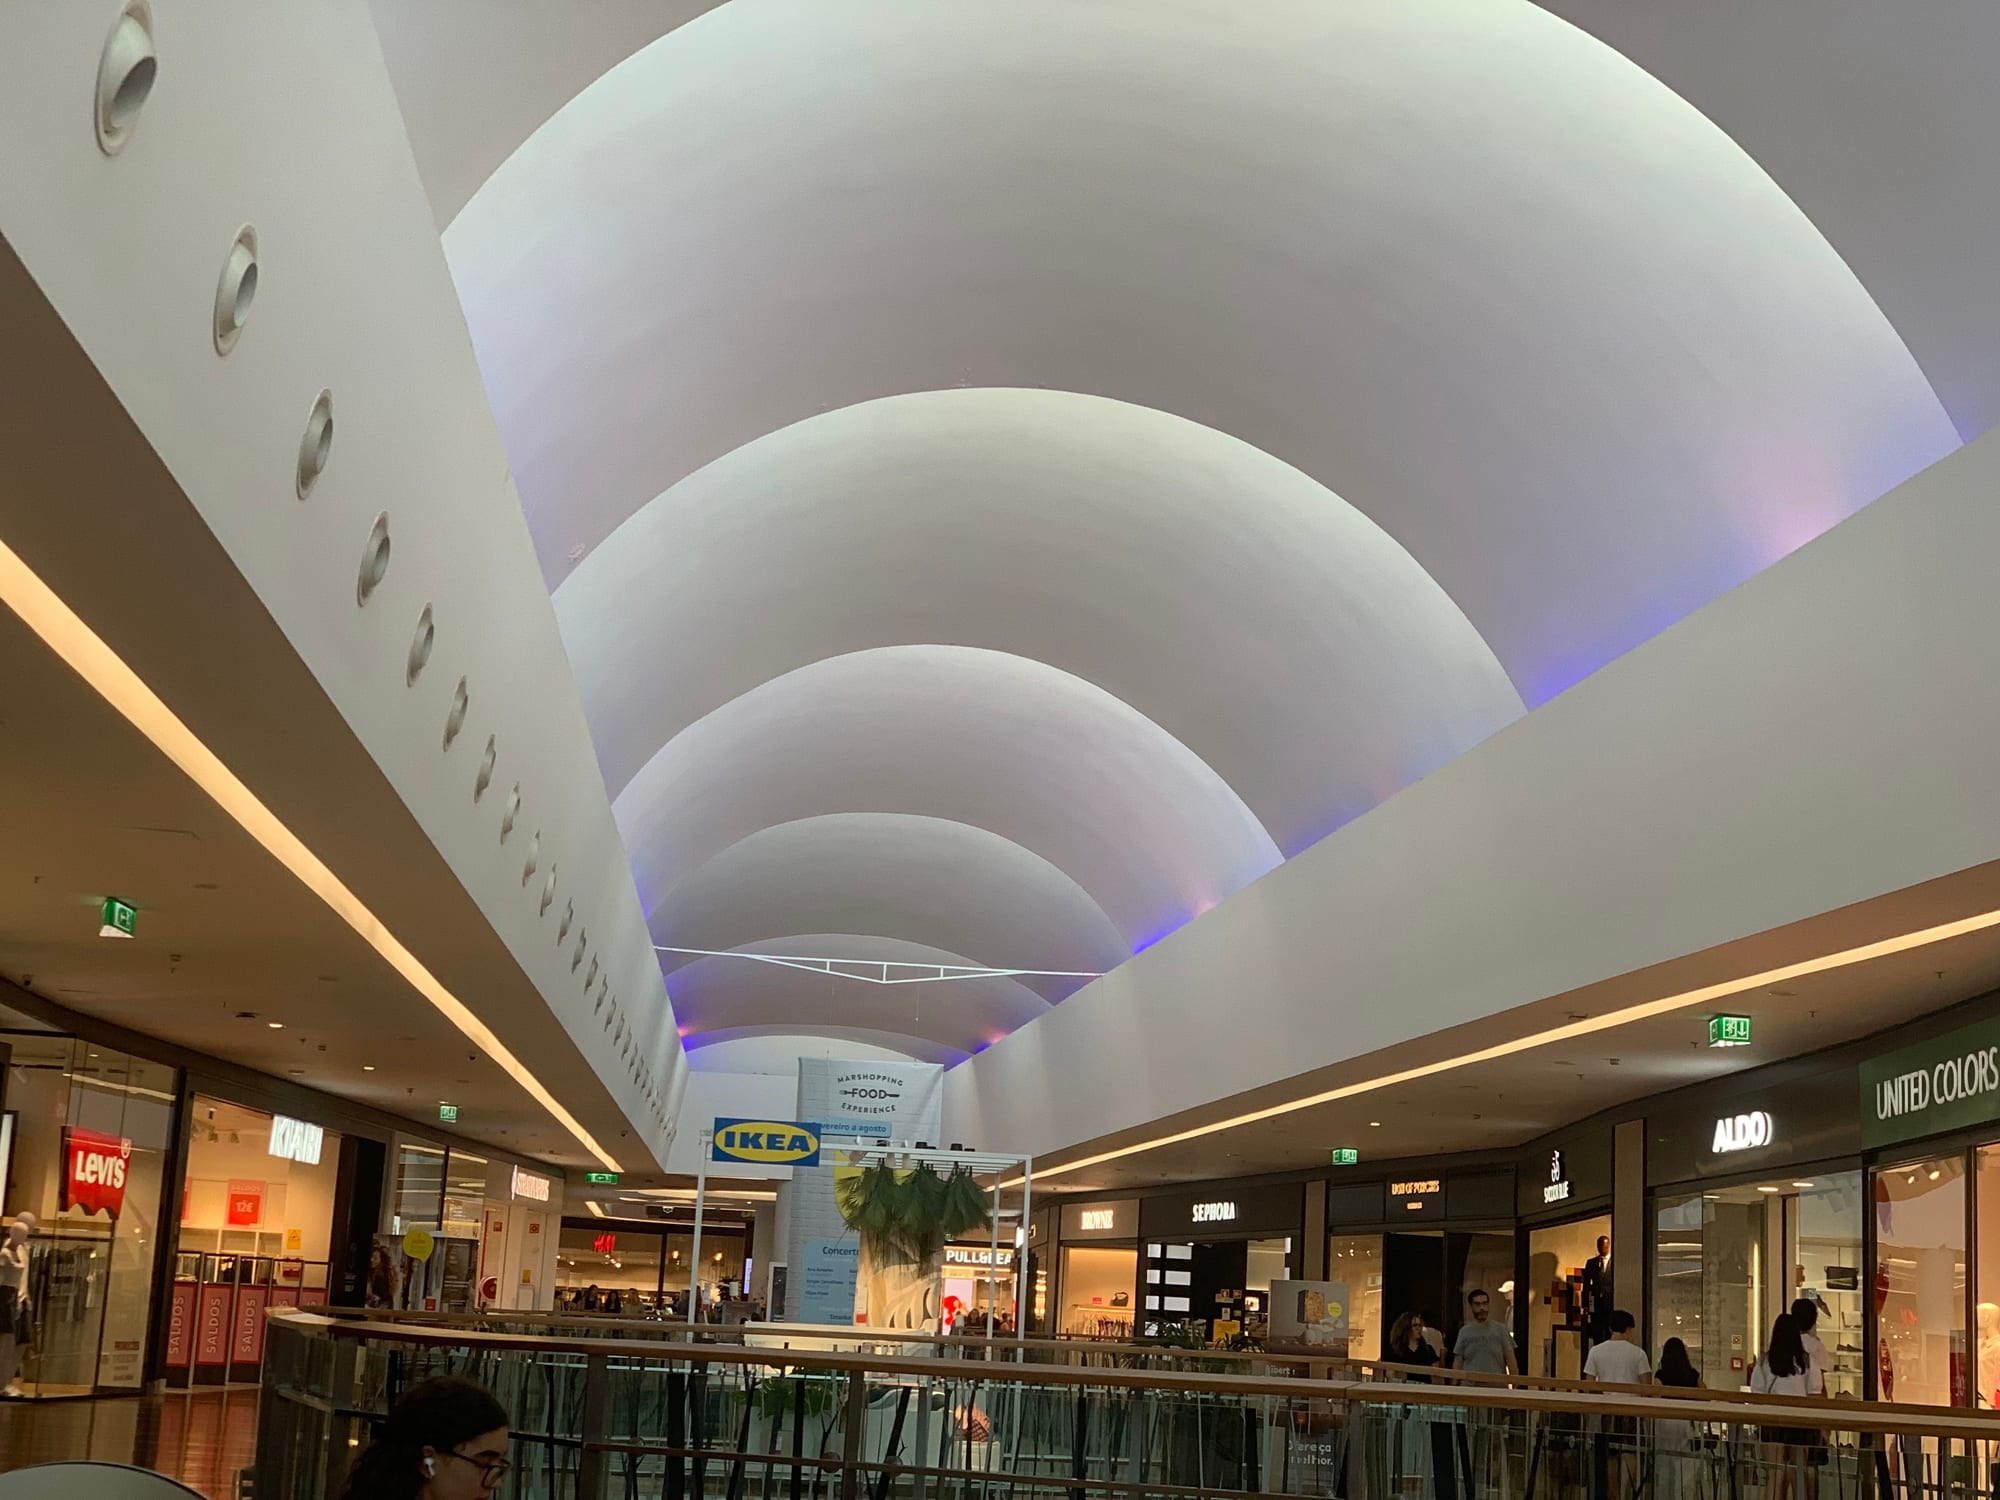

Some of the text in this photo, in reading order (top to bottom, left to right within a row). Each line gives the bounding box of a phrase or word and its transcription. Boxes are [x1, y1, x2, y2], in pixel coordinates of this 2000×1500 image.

[837, 1074, 904, 1087] MARSHOPPING
[1876, 1046, 1999, 1120] UNITED COLORS
[851, 1088, 887, 1099] FOOD
[841, 1102, 896, 1114] EXPERIENCE
[821, 1123, 850, 1131] vereiro
[858, 1126, 887, 1134] agosto
[1712, 1110, 1770, 1153] ALDO
[723, 1131, 812, 1153] IKEA
[1191, 1202, 1236, 1223] SEPHORA
[945, 1250, 1012, 1265] PULL&EA
[168, 1296, 185, 1355] SALDOS
[206, 1297, 222, 1354] SALDOS
[241, 1299, 257, 1353] SALDOS
